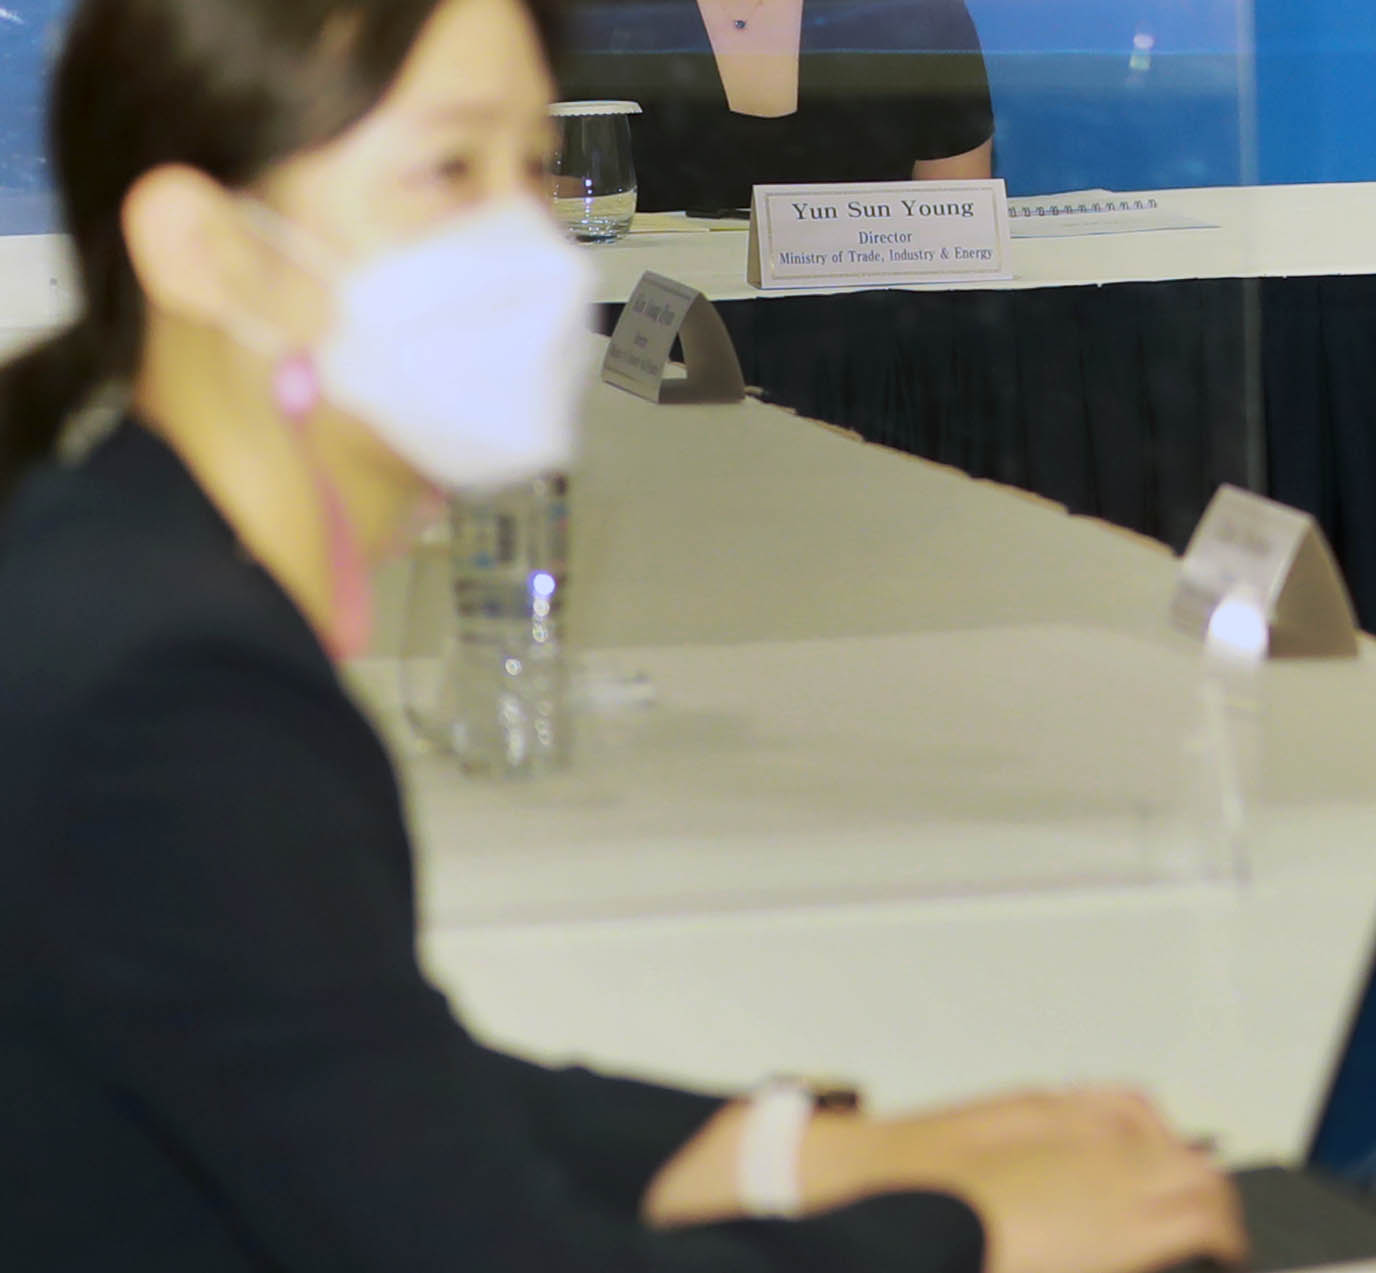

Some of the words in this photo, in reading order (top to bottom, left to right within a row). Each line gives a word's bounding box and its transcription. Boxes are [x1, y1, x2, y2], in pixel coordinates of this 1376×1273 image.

[792, 202, 838, 220] Yun
[847, 200, 891, 218] Sun
[901, 199, 974, 218] Young
[858, 231, 913, 245] Director
[779, 251, 826, 266] Ministry
[832, 250, 843, 263] of
[848, 249, 885, 263] Trade,
[889, 247, 935, 263] Industry
[940, 248, 949, 260] &
[954, 246, 993, 261] Energy
